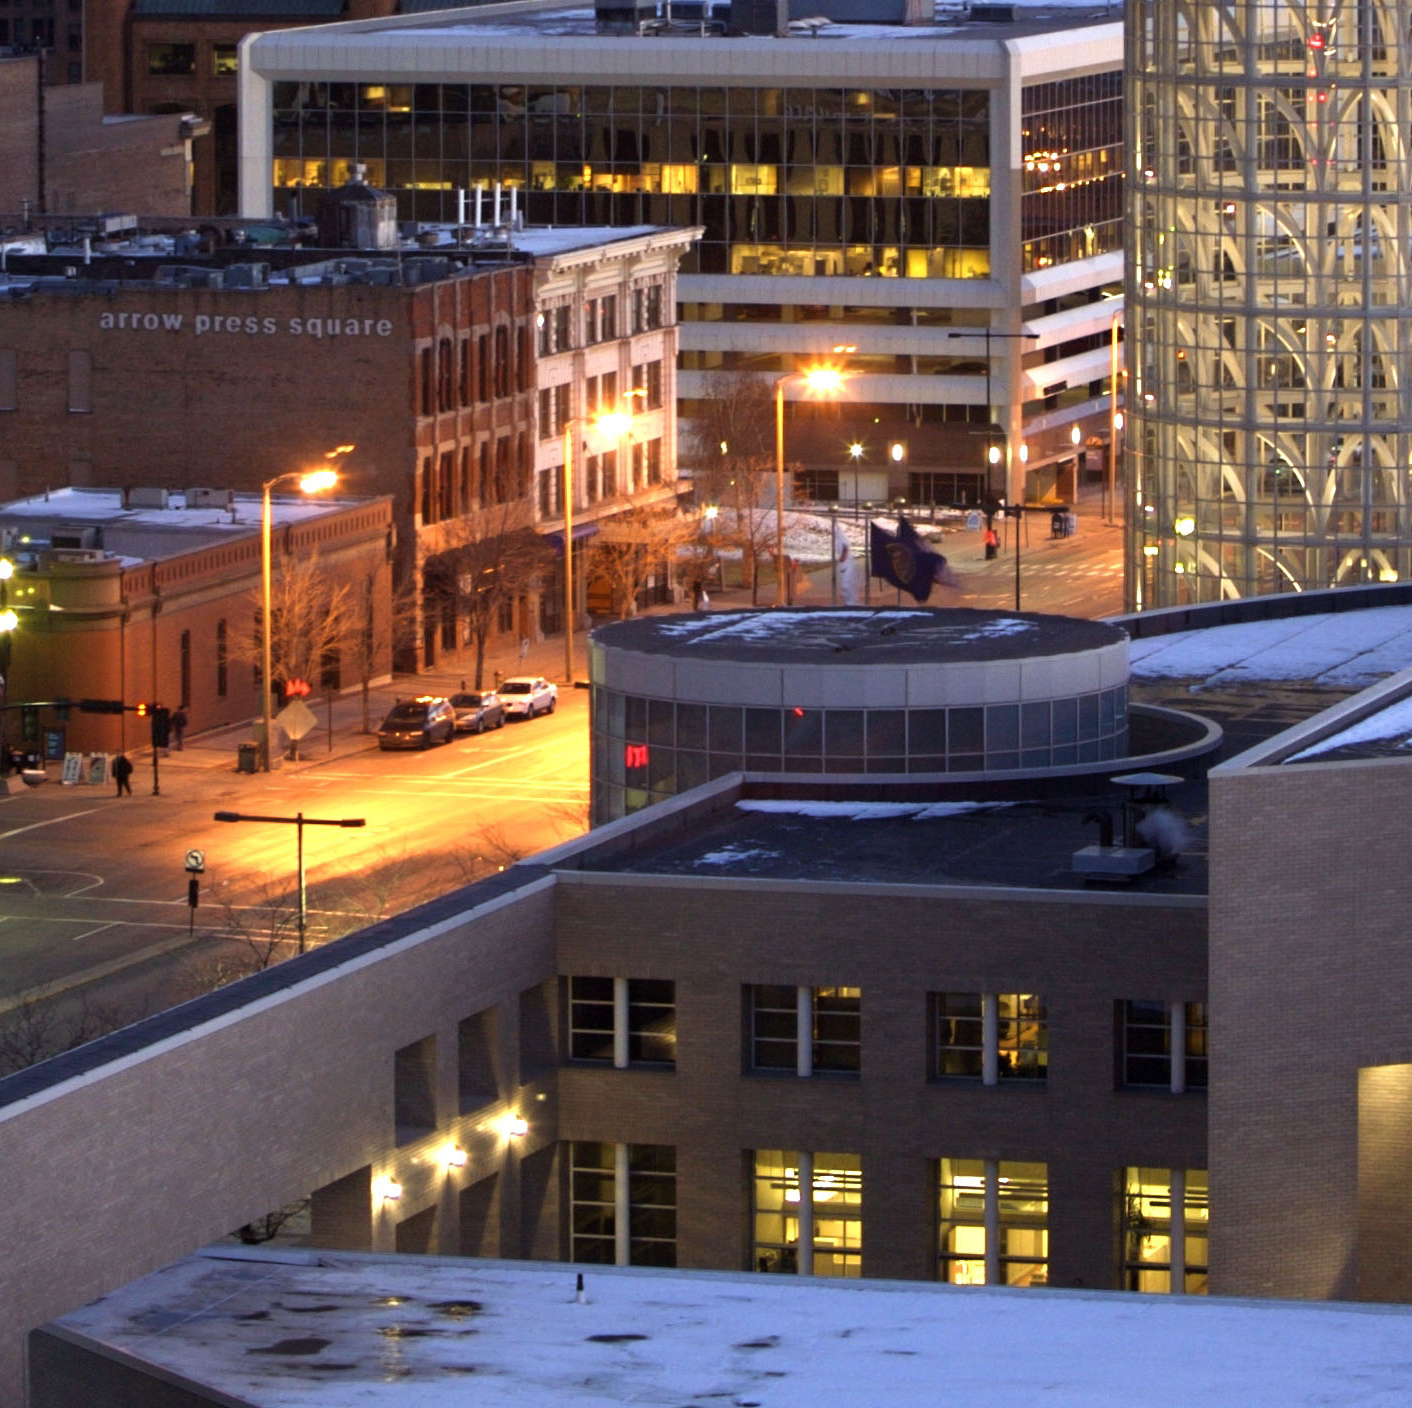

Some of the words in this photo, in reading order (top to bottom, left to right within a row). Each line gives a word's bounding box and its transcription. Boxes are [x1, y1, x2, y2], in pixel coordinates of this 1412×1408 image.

[98, 311, 184, 332] arrow
[193, 314, 278, 335] press
[288, 316, 394, 339] square
